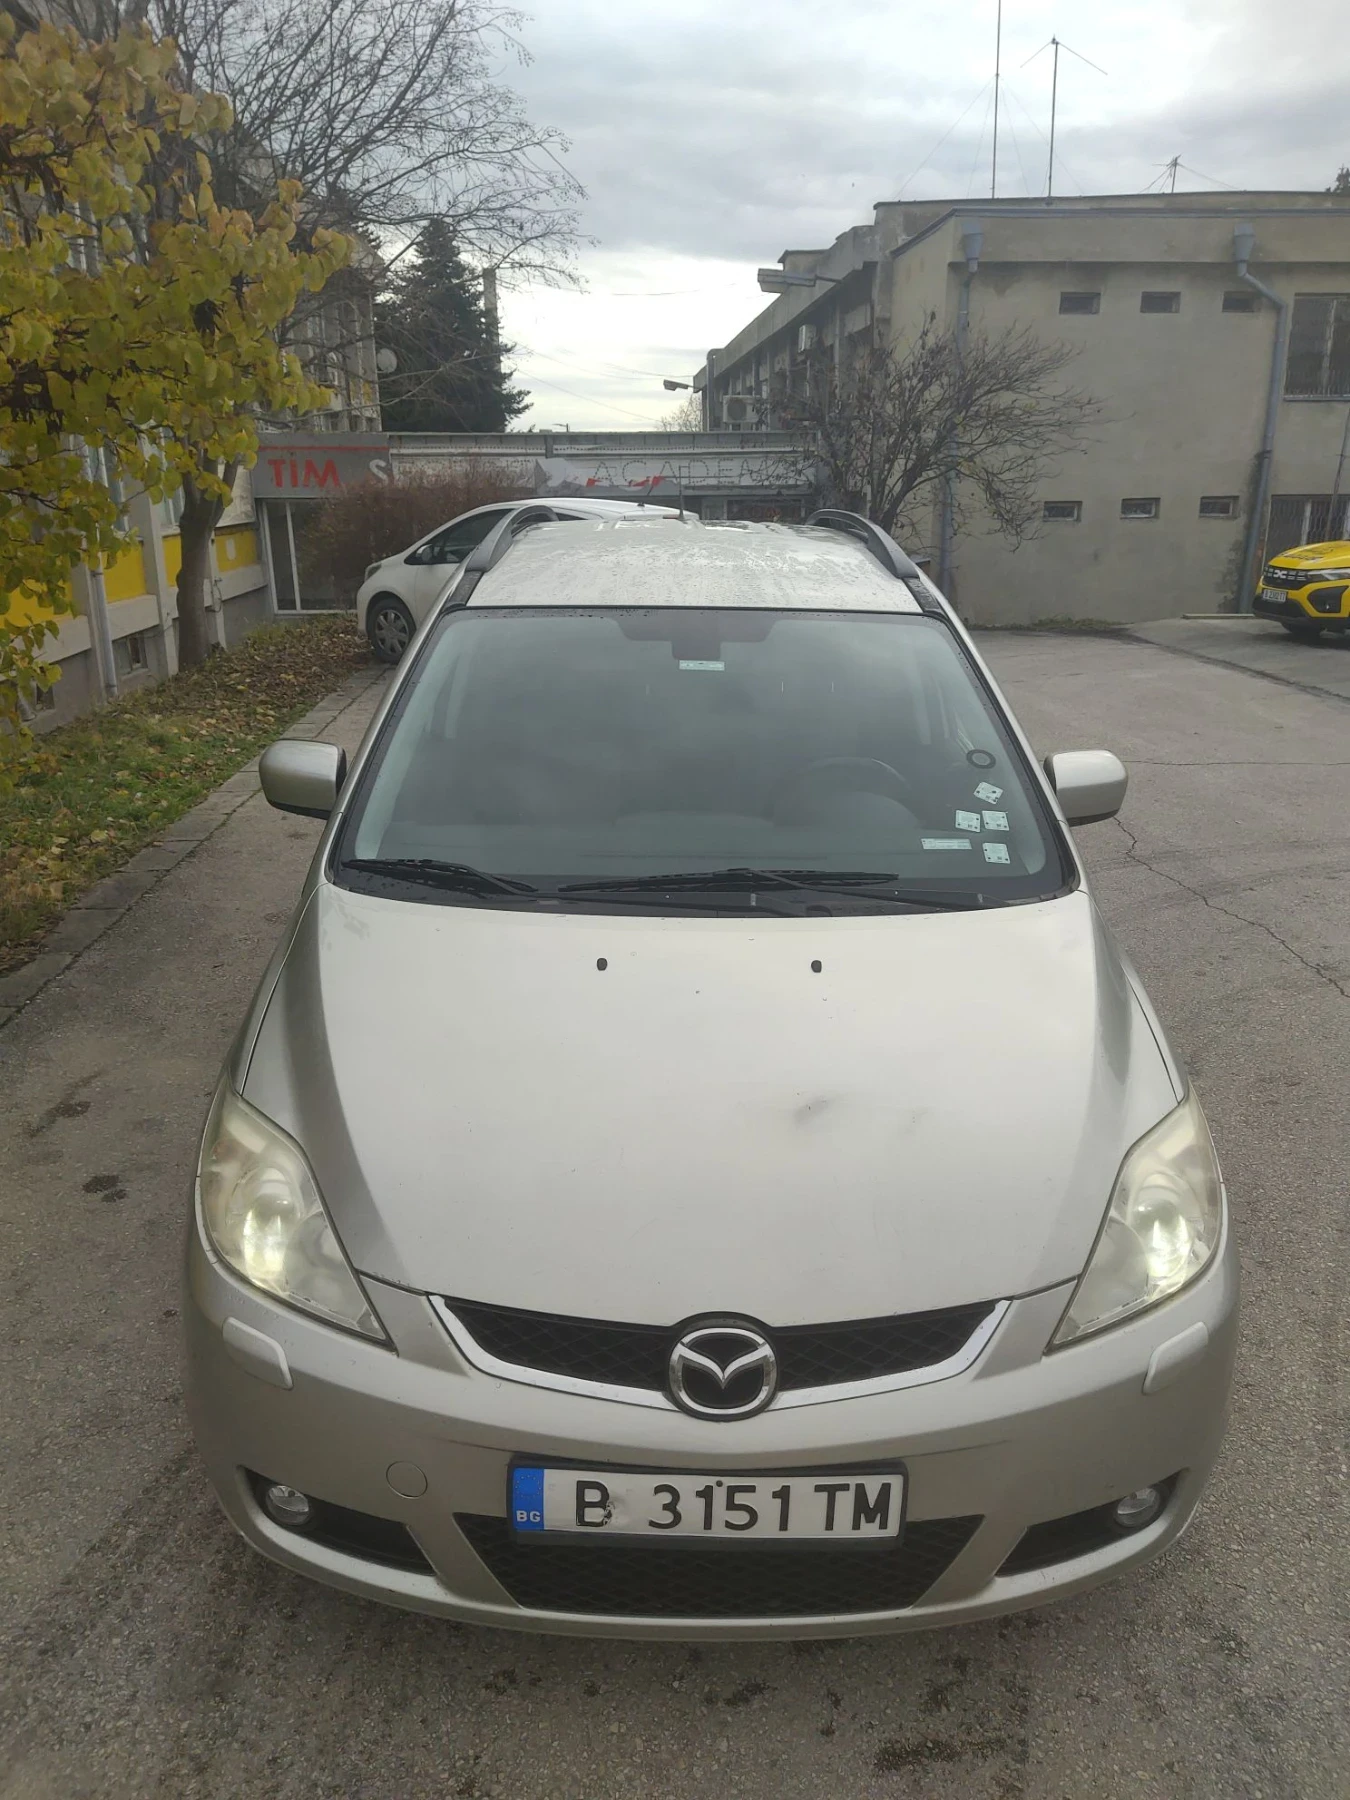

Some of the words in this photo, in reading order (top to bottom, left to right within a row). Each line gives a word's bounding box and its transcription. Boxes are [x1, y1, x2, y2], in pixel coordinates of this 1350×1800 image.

[516, 1510, 541, 1522] BG
[576, 1480, 611, 1528] B
[648, 1484, 791, 1531] 3151
[814, 1483, 892, 1531] TM
